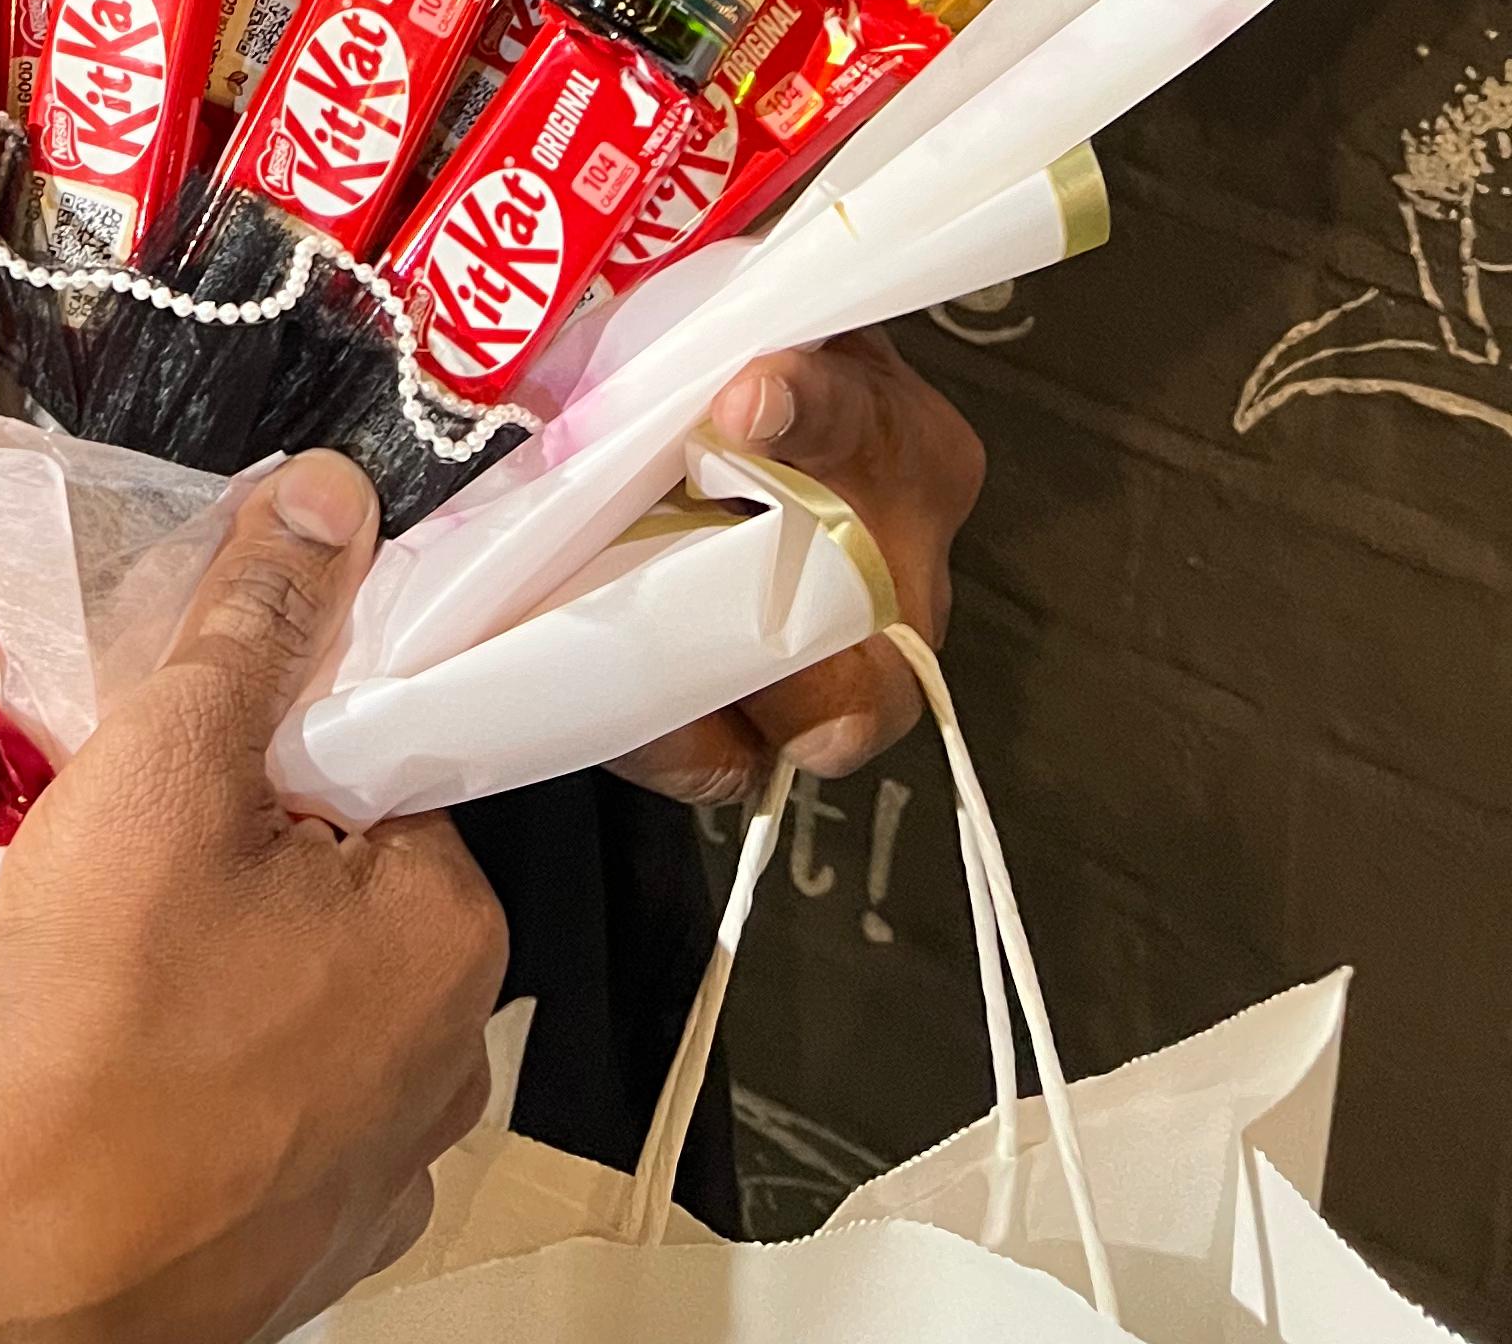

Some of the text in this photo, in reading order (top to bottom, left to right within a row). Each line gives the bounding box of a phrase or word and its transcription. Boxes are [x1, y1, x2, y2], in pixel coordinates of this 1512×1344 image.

[18, 60, 34, 103] GOOD
[284, 11, 407, 207] KitKat
[531, 68, 600, 171] ORIGINAL
[582, 152, 618, 192] 104
[428, 171, 560, 371] KitKat
